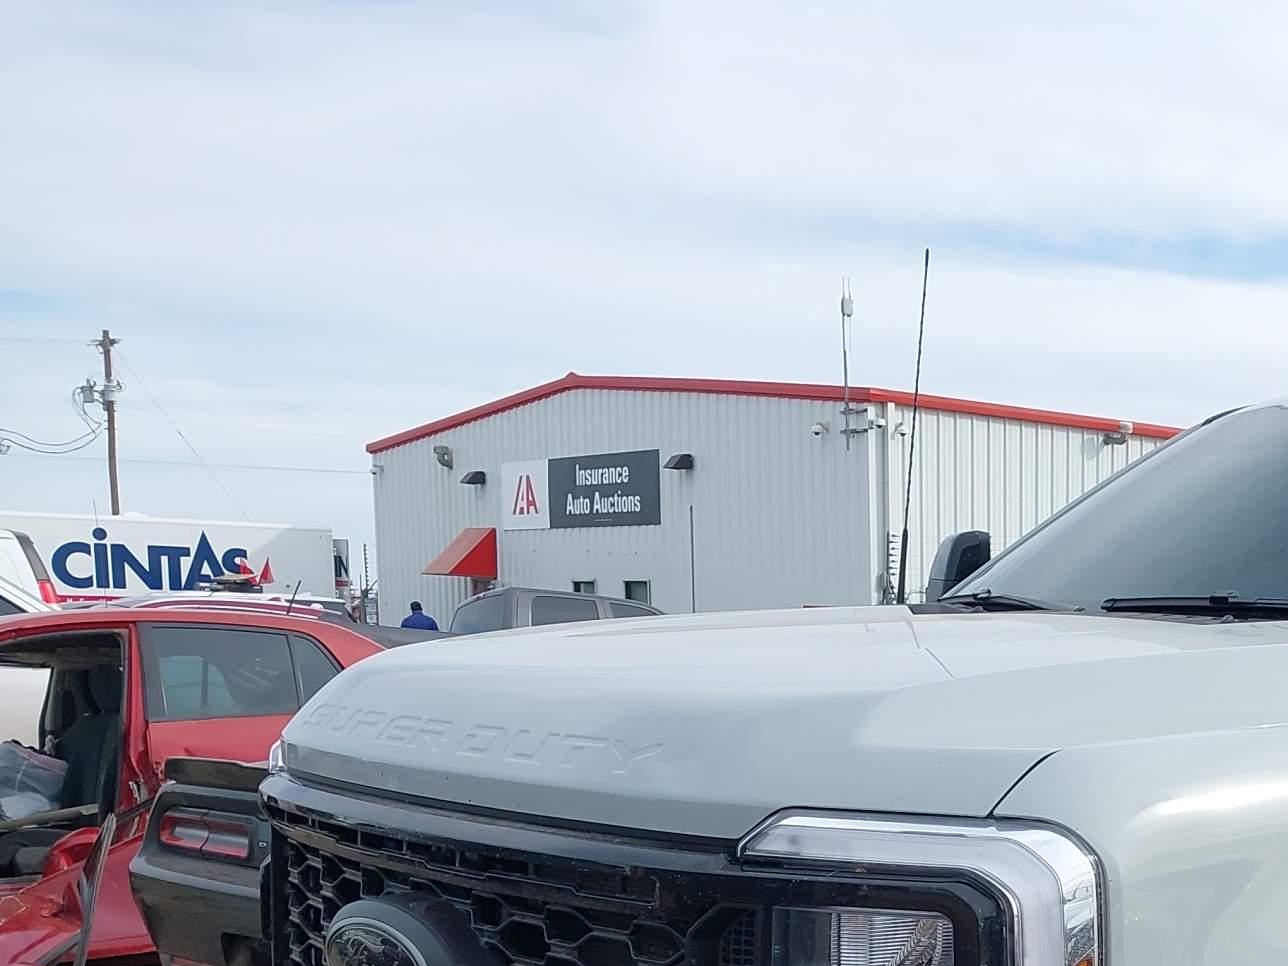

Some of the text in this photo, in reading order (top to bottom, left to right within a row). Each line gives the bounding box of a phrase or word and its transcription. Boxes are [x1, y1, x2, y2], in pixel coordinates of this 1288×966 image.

[575, 463, 630, 487] Insurance
[565, 489, 642, 516] Auto Auctions
[302, 702, 665, 775] SUPER DUTY
